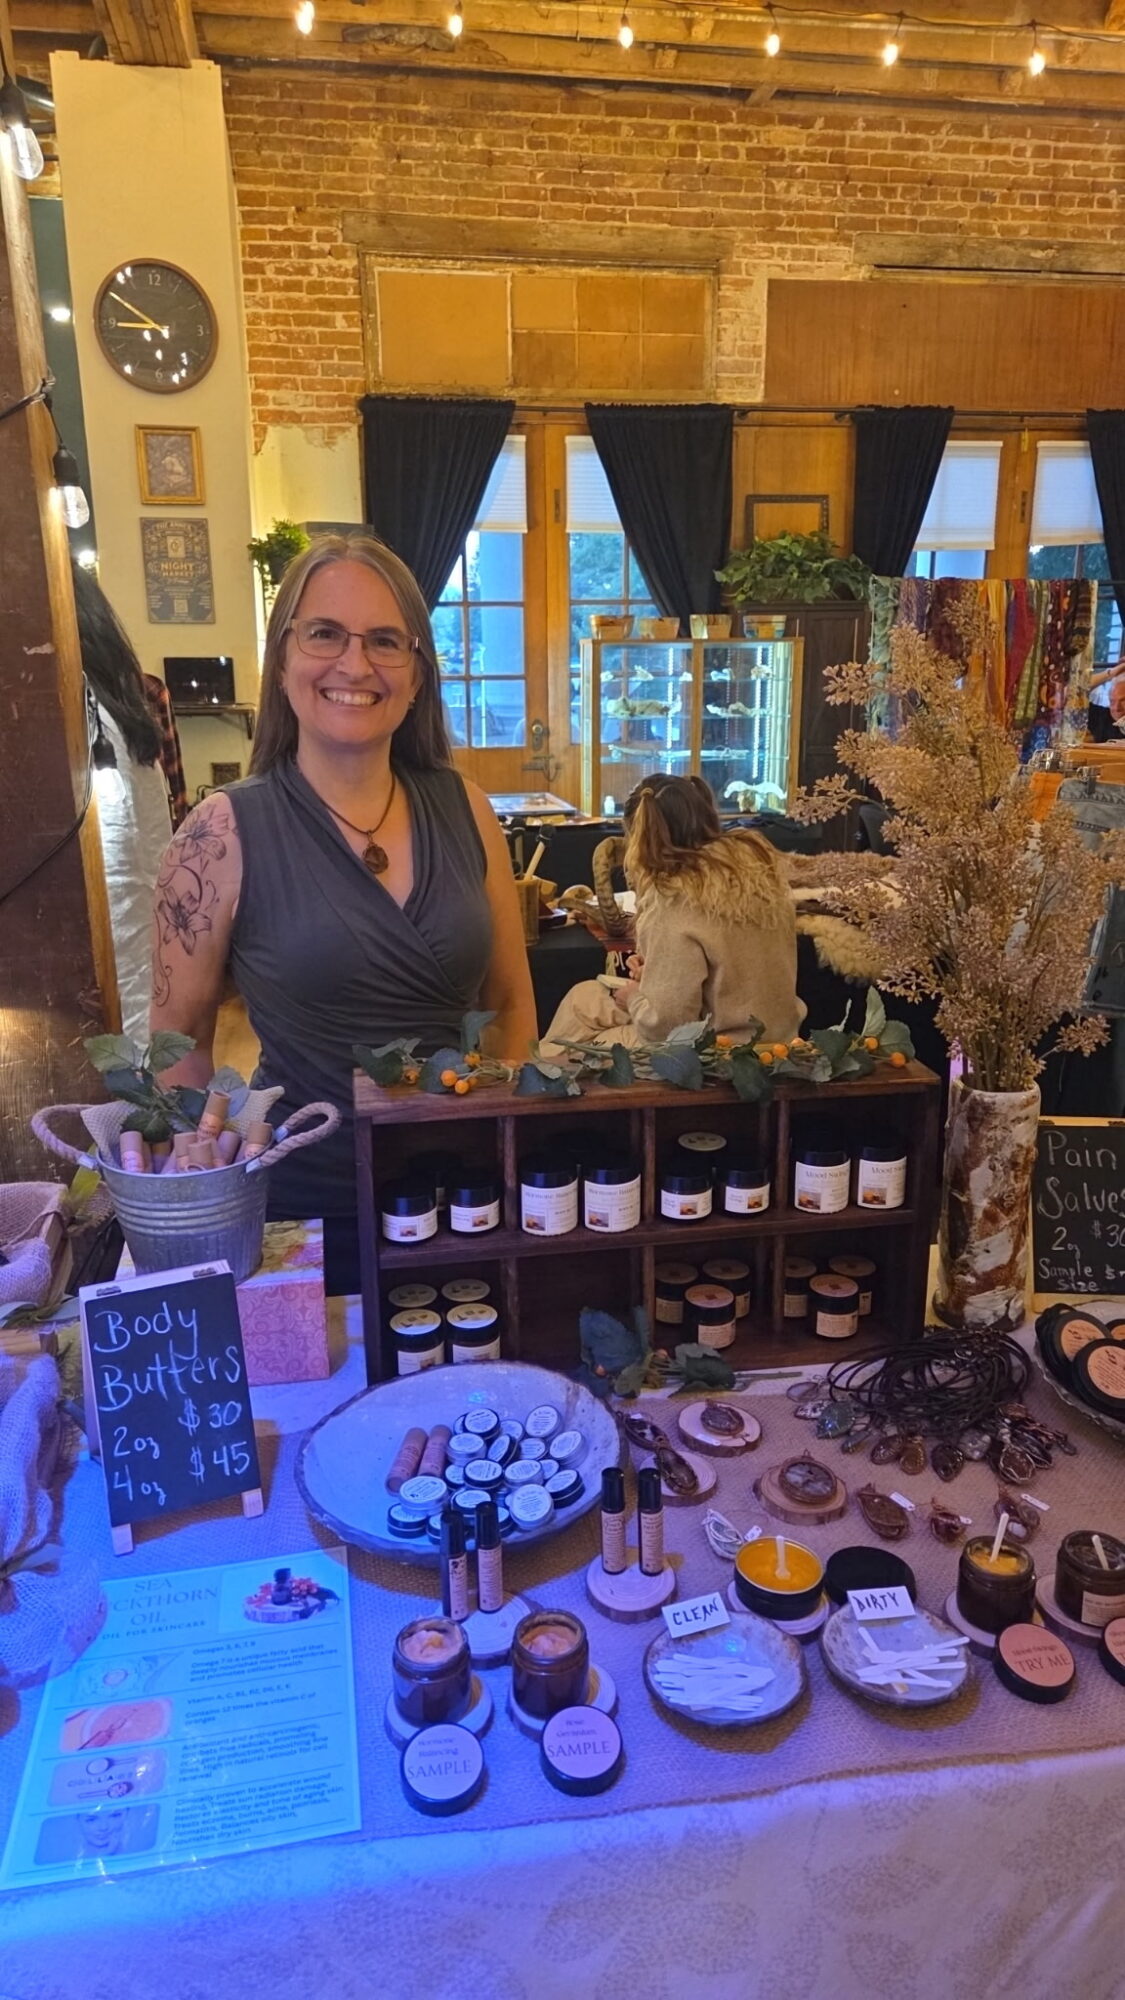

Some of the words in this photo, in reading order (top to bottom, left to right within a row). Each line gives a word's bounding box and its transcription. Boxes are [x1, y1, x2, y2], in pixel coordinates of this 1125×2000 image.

[148, 274, 161, 286] 12
[108, 317, 117, 329] 9
[197, 325, 205, 337] 3
[155, 368, 163, 379] 6
[160, 561, 193, 571] NIGHT
[1043, 1130, 1117, 1171] Pain
[1038, 1257, 1094, 1283] Sample
[94, 1301, 198, 1360] Body
[98, 1339, 241, 1411] Butters
[134, 1578, 173, 1593] SEA
[112, 1587, 219, 1612] CKTHORN
[856, 1592, 901, 1613] DIRTY
[130, 1611, 167, 1626] OIL
[672, 1597, 720, 1626] CLEAN
[126, 1628, 147, 1637] FOR
[151, 1620, 206, 1633] SKINCARE
[1015, 1657, 1044, 1672] TRY
[1048, 1653, 1072, 1668] ME
[207, 1669, 245, 1681] promotes
[185, 1708, 220, 1719] Contains
[232, 1703, 254, 1711] times
[185, 1716, 216, 1726] oranges
[547, 1741, 611, 1758] SAMPLE
[203, 1762, 223, 1771] High
[407, 1759, 472, 1779] SAMPLE
[178, 1772, 212, 1782] renewal
[216, 1789, 246, 1800] proven
